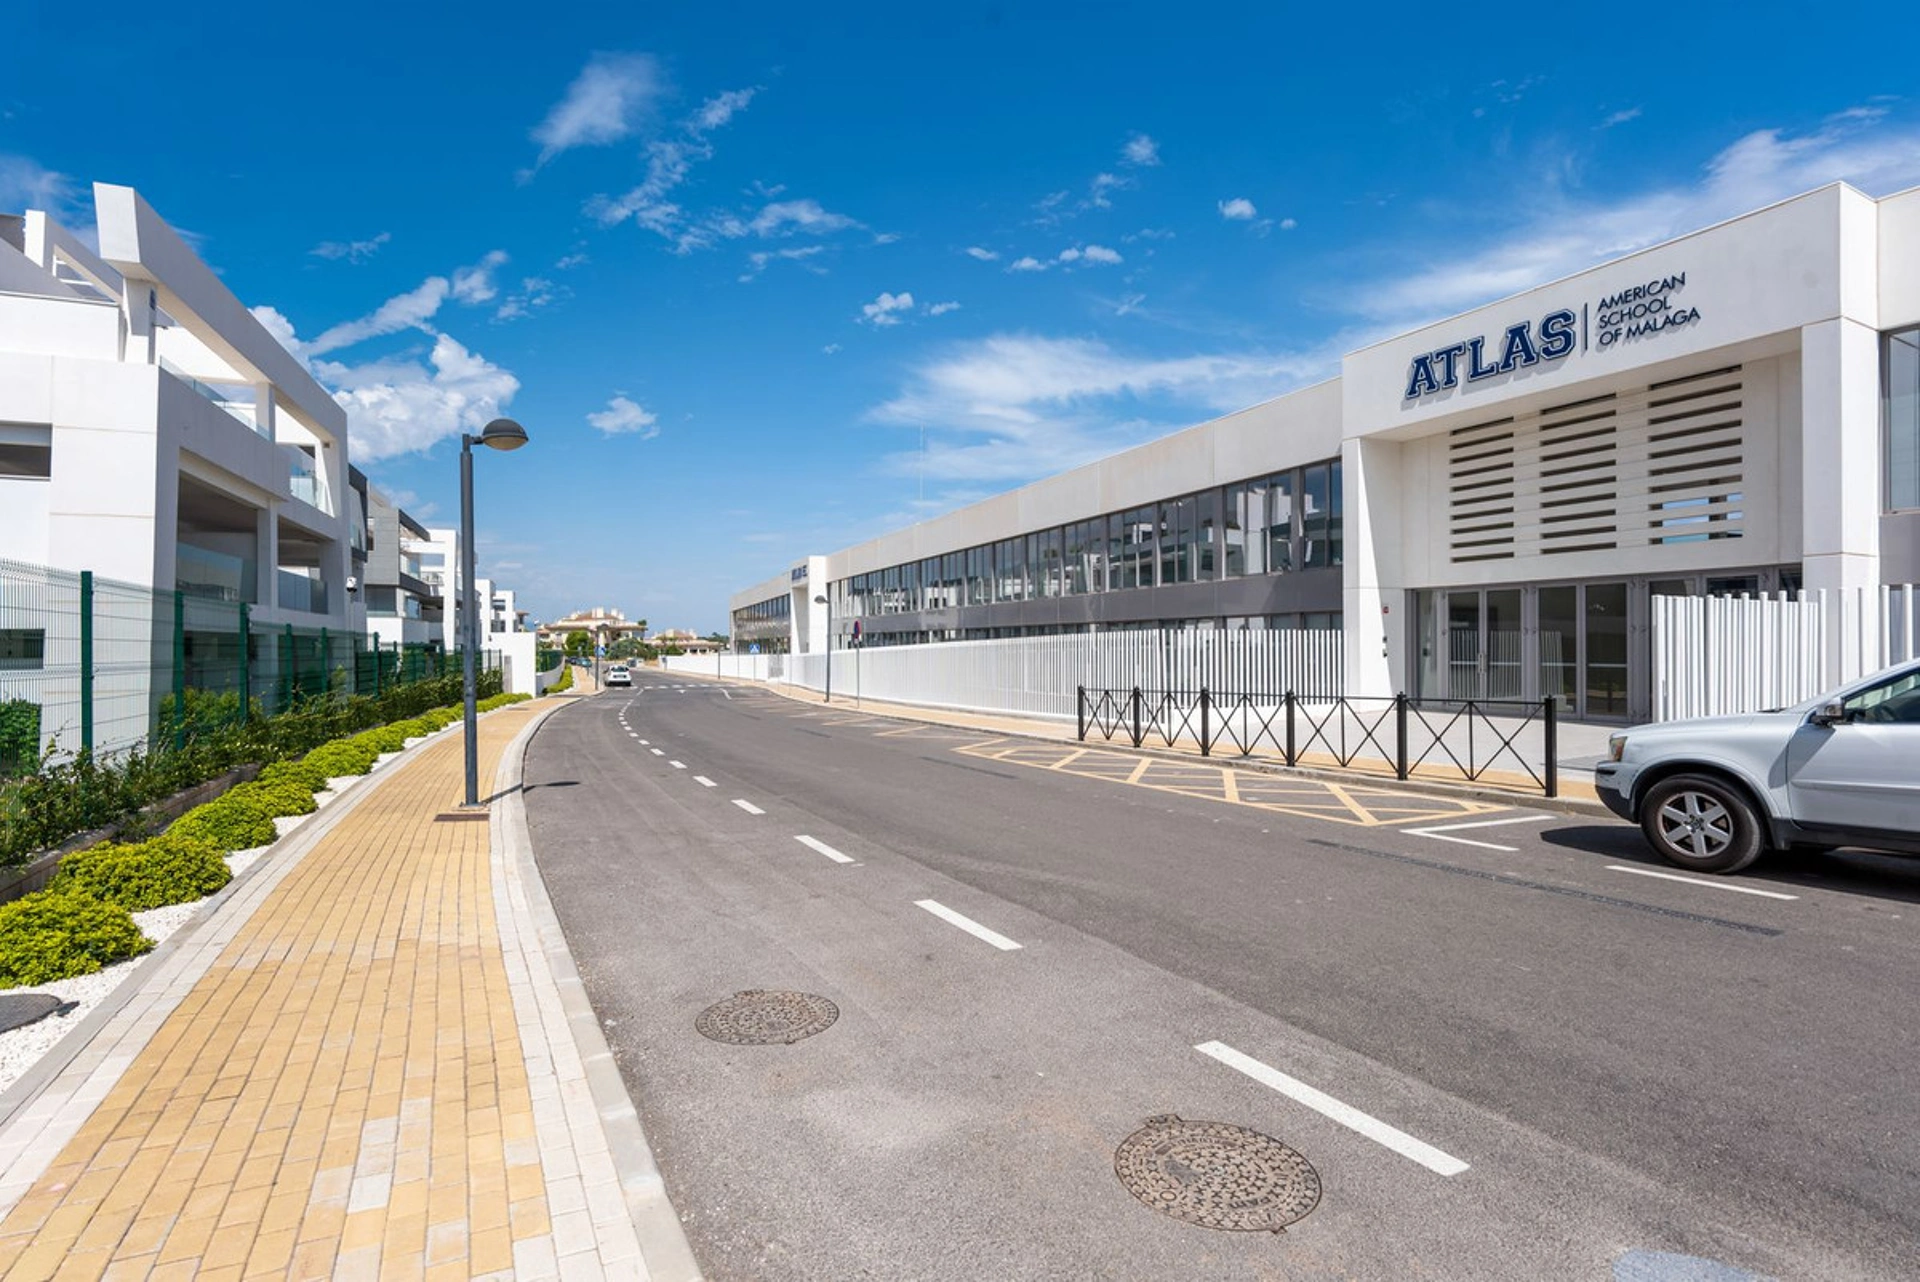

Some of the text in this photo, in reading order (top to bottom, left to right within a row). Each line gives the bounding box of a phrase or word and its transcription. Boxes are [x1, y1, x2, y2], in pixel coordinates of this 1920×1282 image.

[1598, 272, 1686, 312] AMERICAN
[1599, 297, 1672, 329] SCHOOL
[1599, 307, 1701, 345] OF MALAGA
[1405, 309, 1576, 399] ATLAS
